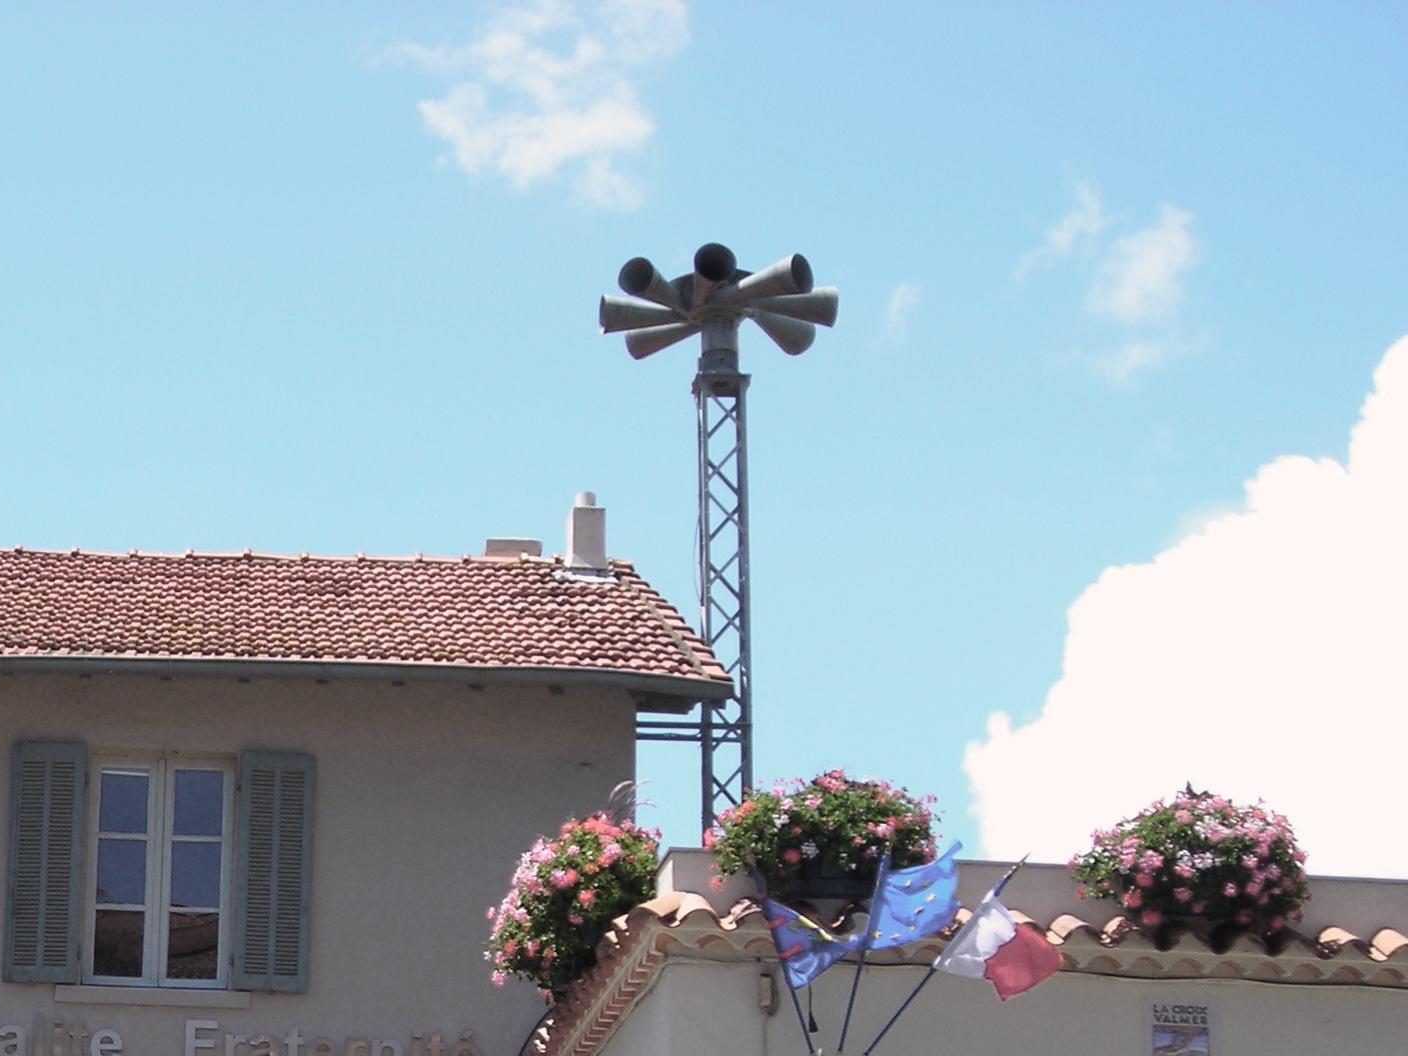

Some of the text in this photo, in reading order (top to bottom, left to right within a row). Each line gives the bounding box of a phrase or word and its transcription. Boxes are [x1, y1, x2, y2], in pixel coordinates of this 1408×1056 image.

[1153, 1004, 1209, 1015] LA CROIX
[1153, 1014, 1209, 1025] VALMER
